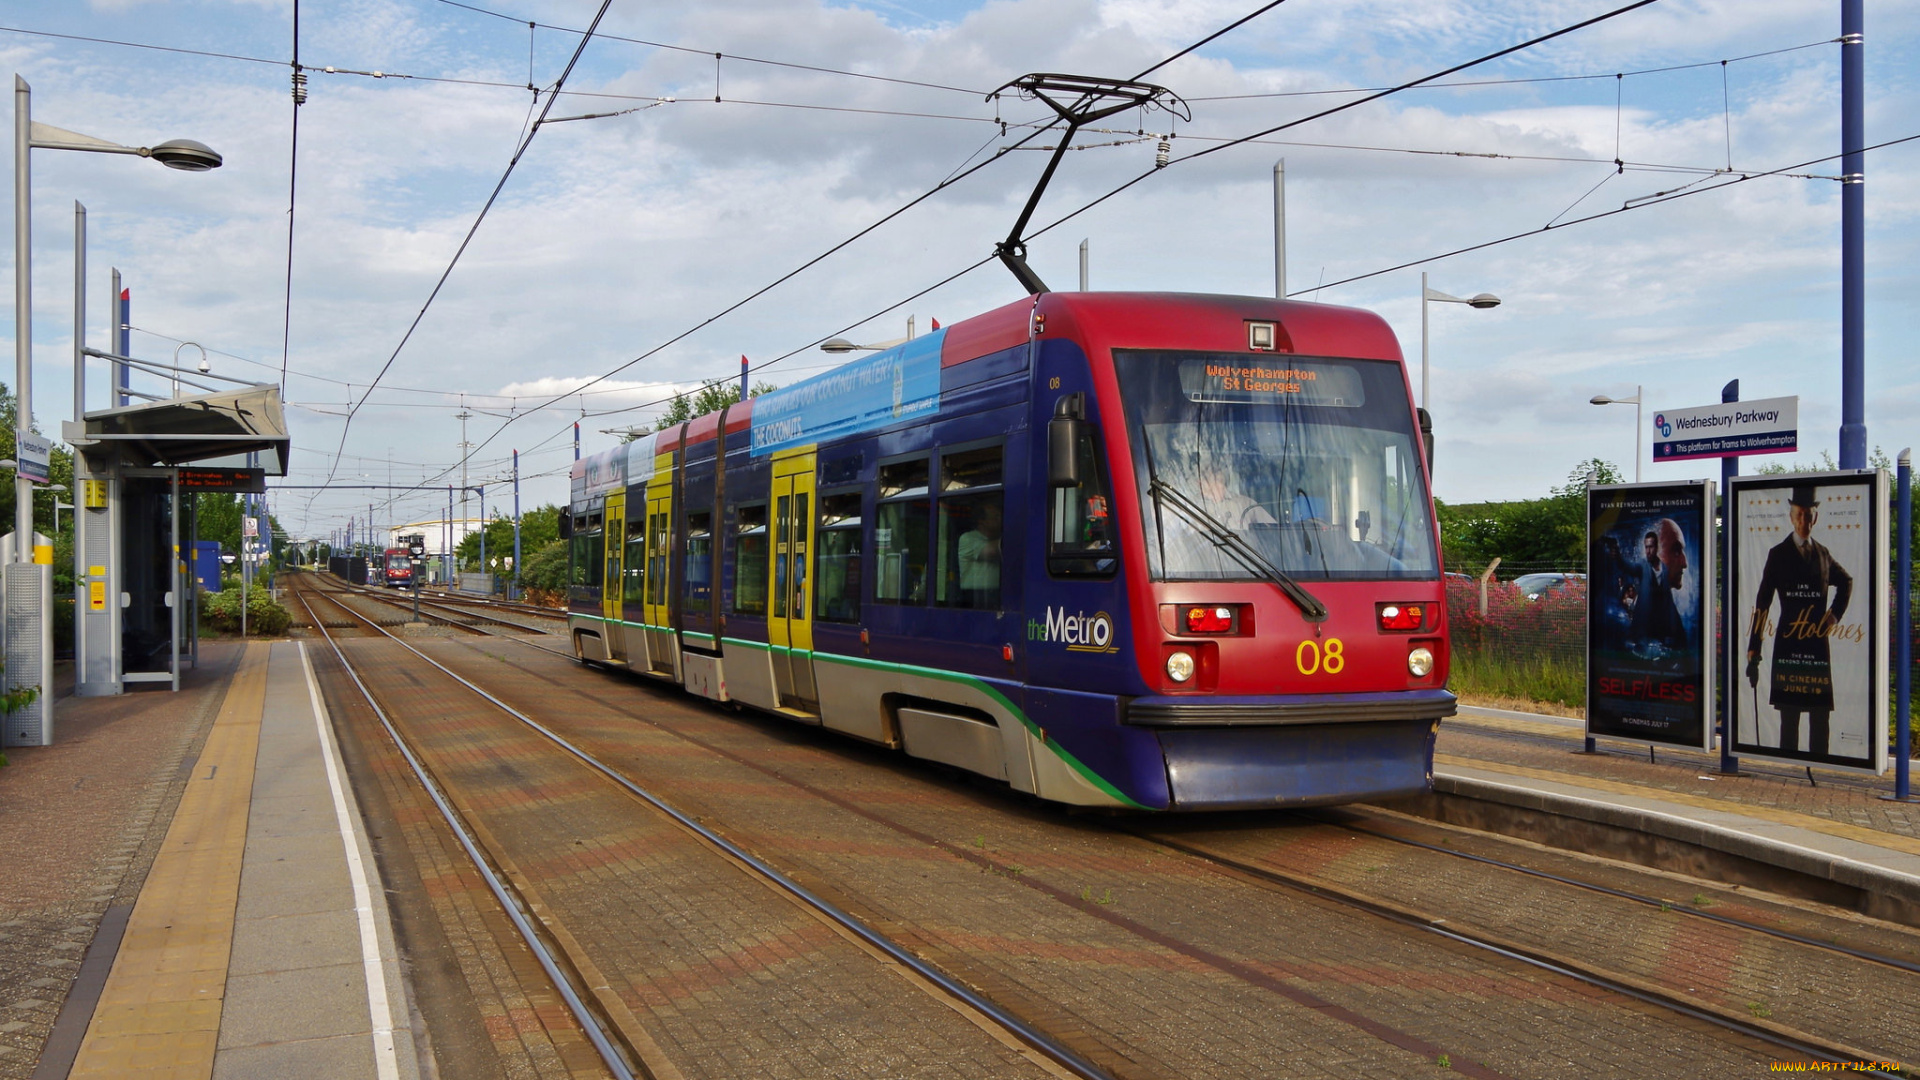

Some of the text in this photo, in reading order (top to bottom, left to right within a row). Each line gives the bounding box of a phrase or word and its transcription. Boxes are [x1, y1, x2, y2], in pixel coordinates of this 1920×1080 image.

[1206, 365, 1316, 381] Wolverhampton
[1049, 376, 1060, 390] 08
[1223, 377, 1301, 394] St Georges
[1675, 409, 1780, 430] Wednesbury Parkway
[1676, 435, 1796, 454] This platform for Trams to Wolverhampton
[1746, 604, 1866, 643] Mr Holmes
[1296, 637, 1345, 675] 08
[1598, 674, 1696, 702] SELF/LESS
[1789, 675, 1830, 685] CINEMAS
[1783, 685, 1808, 693] JUNE
[1628, 717, 1650, 726] CINEMAS
